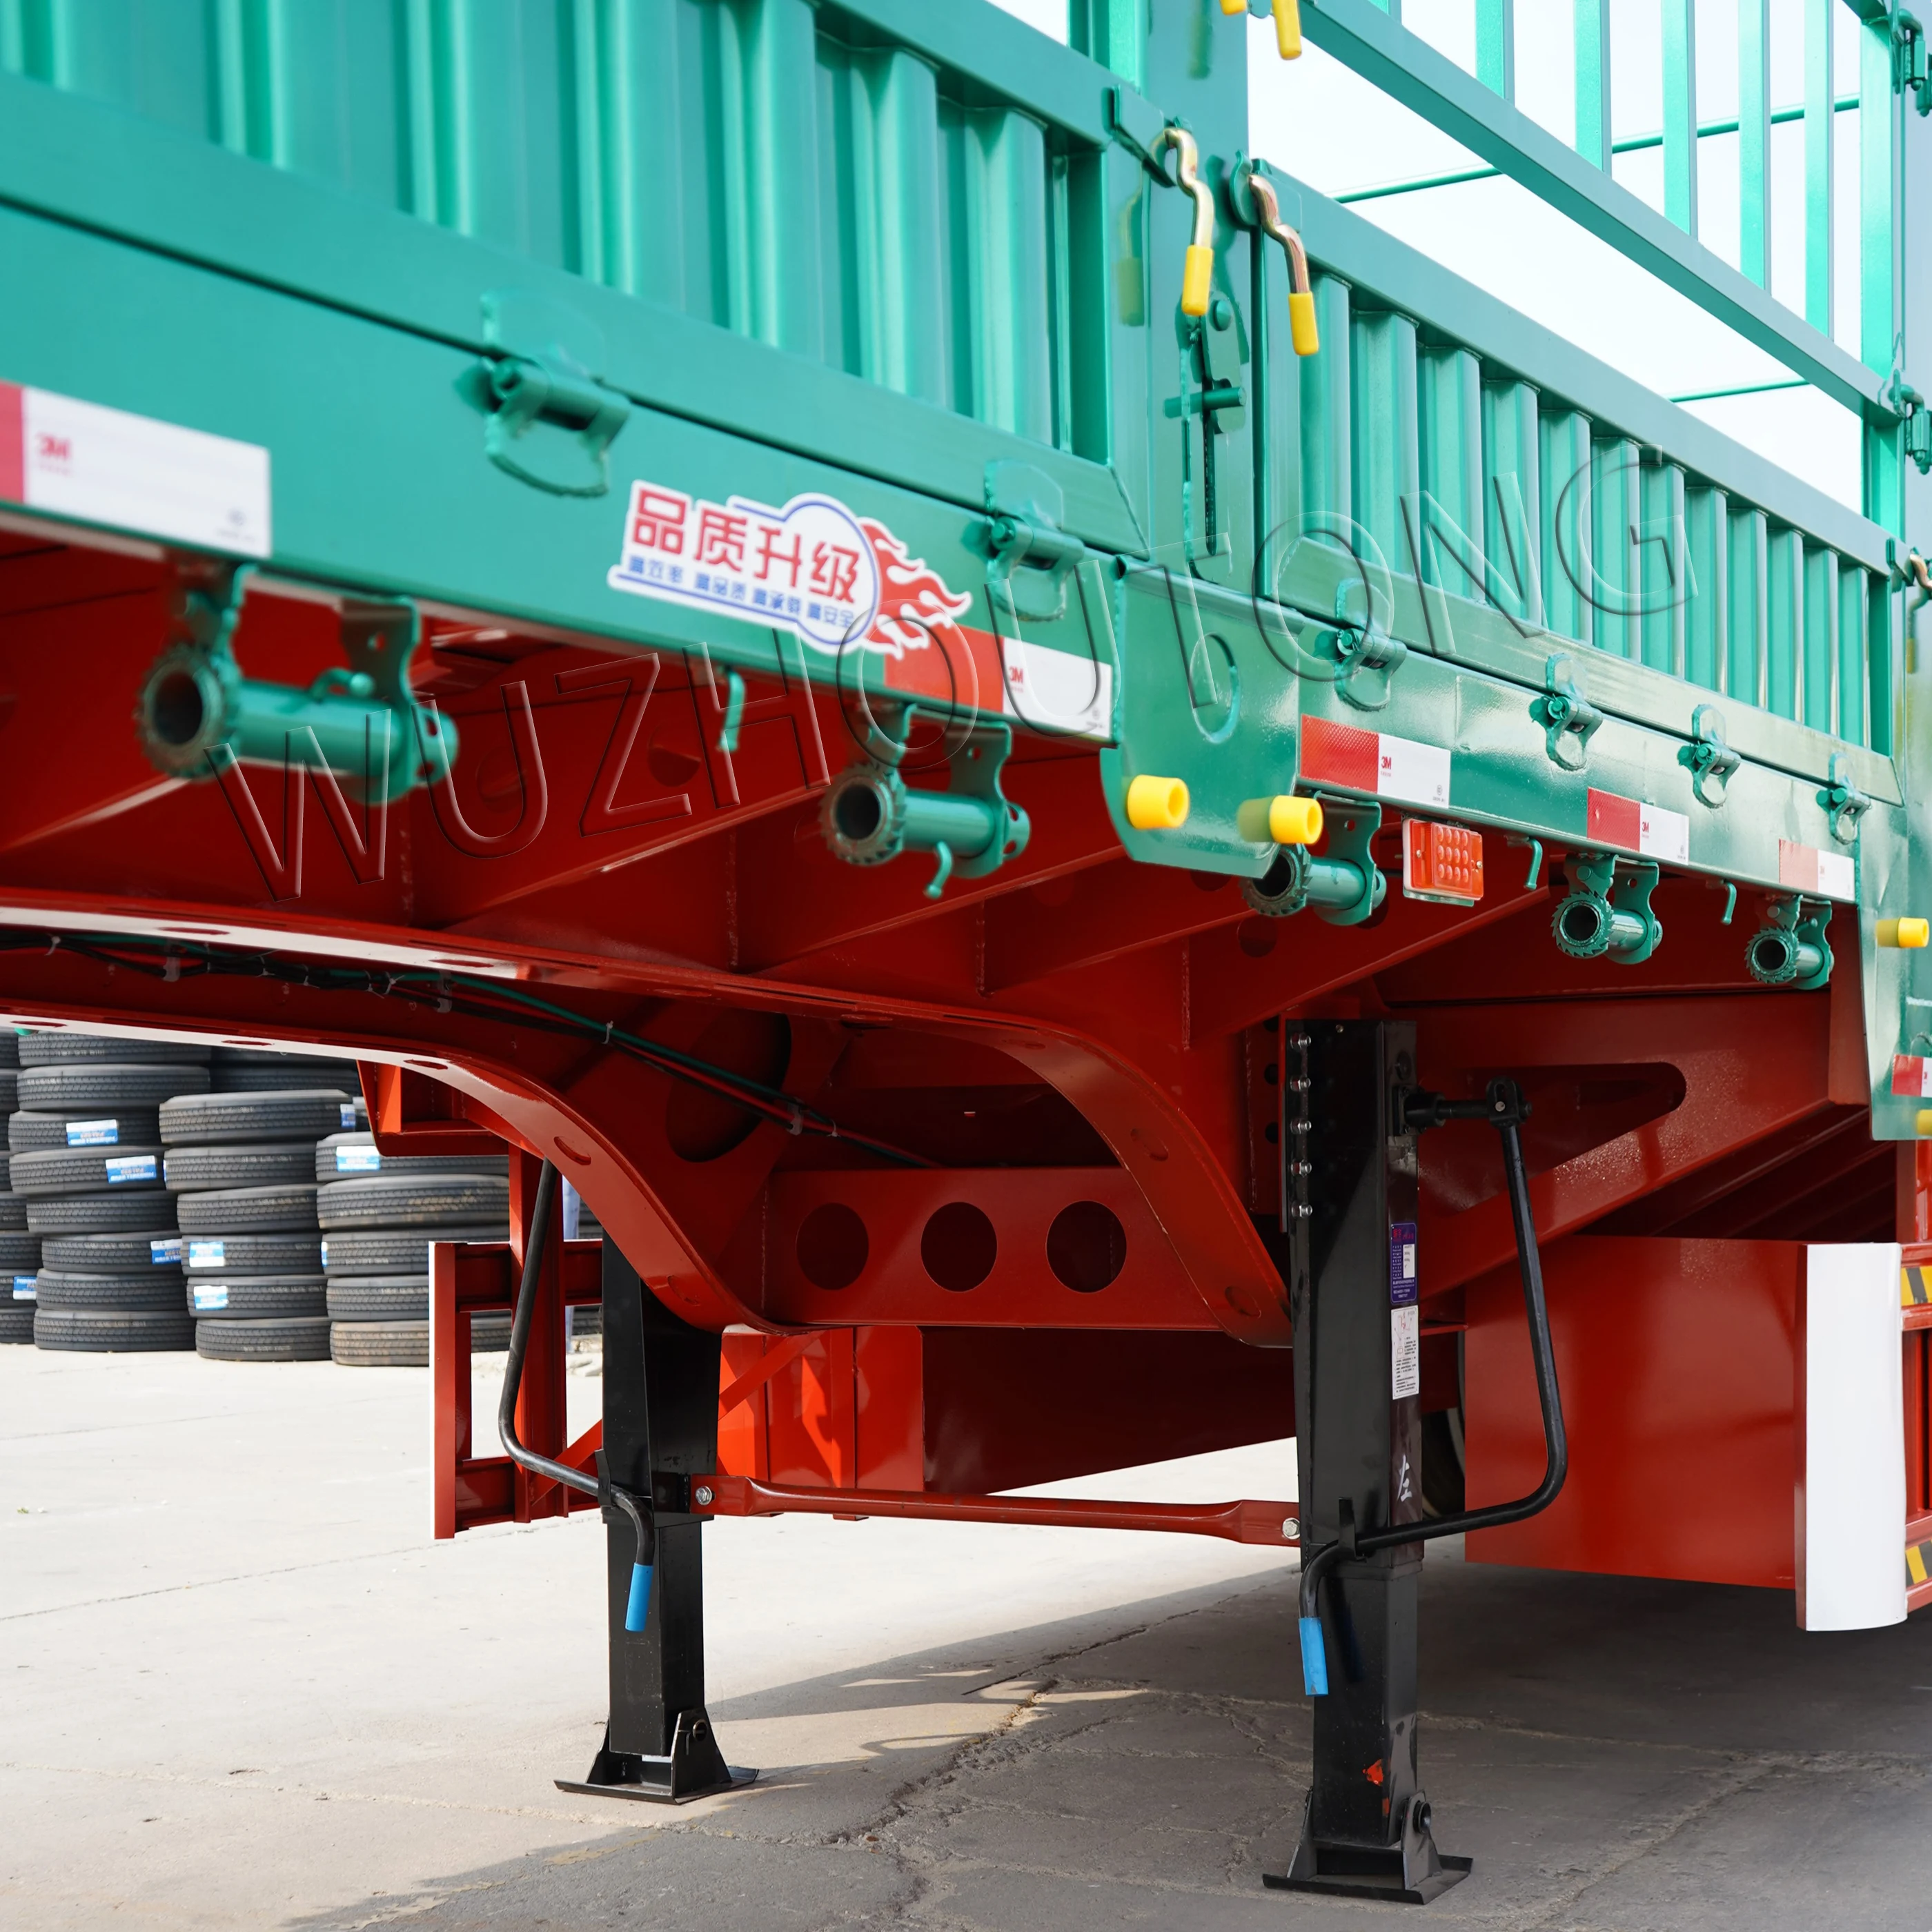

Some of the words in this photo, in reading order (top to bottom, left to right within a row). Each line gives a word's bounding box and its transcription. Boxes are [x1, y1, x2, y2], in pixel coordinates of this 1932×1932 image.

[631, 486, 860, 604] 品质升级
[1009, 665, 1024, 684] 3M
[1381, 756, 1392, 770] 3M
[1642, 821, 1650, 833] 3M
